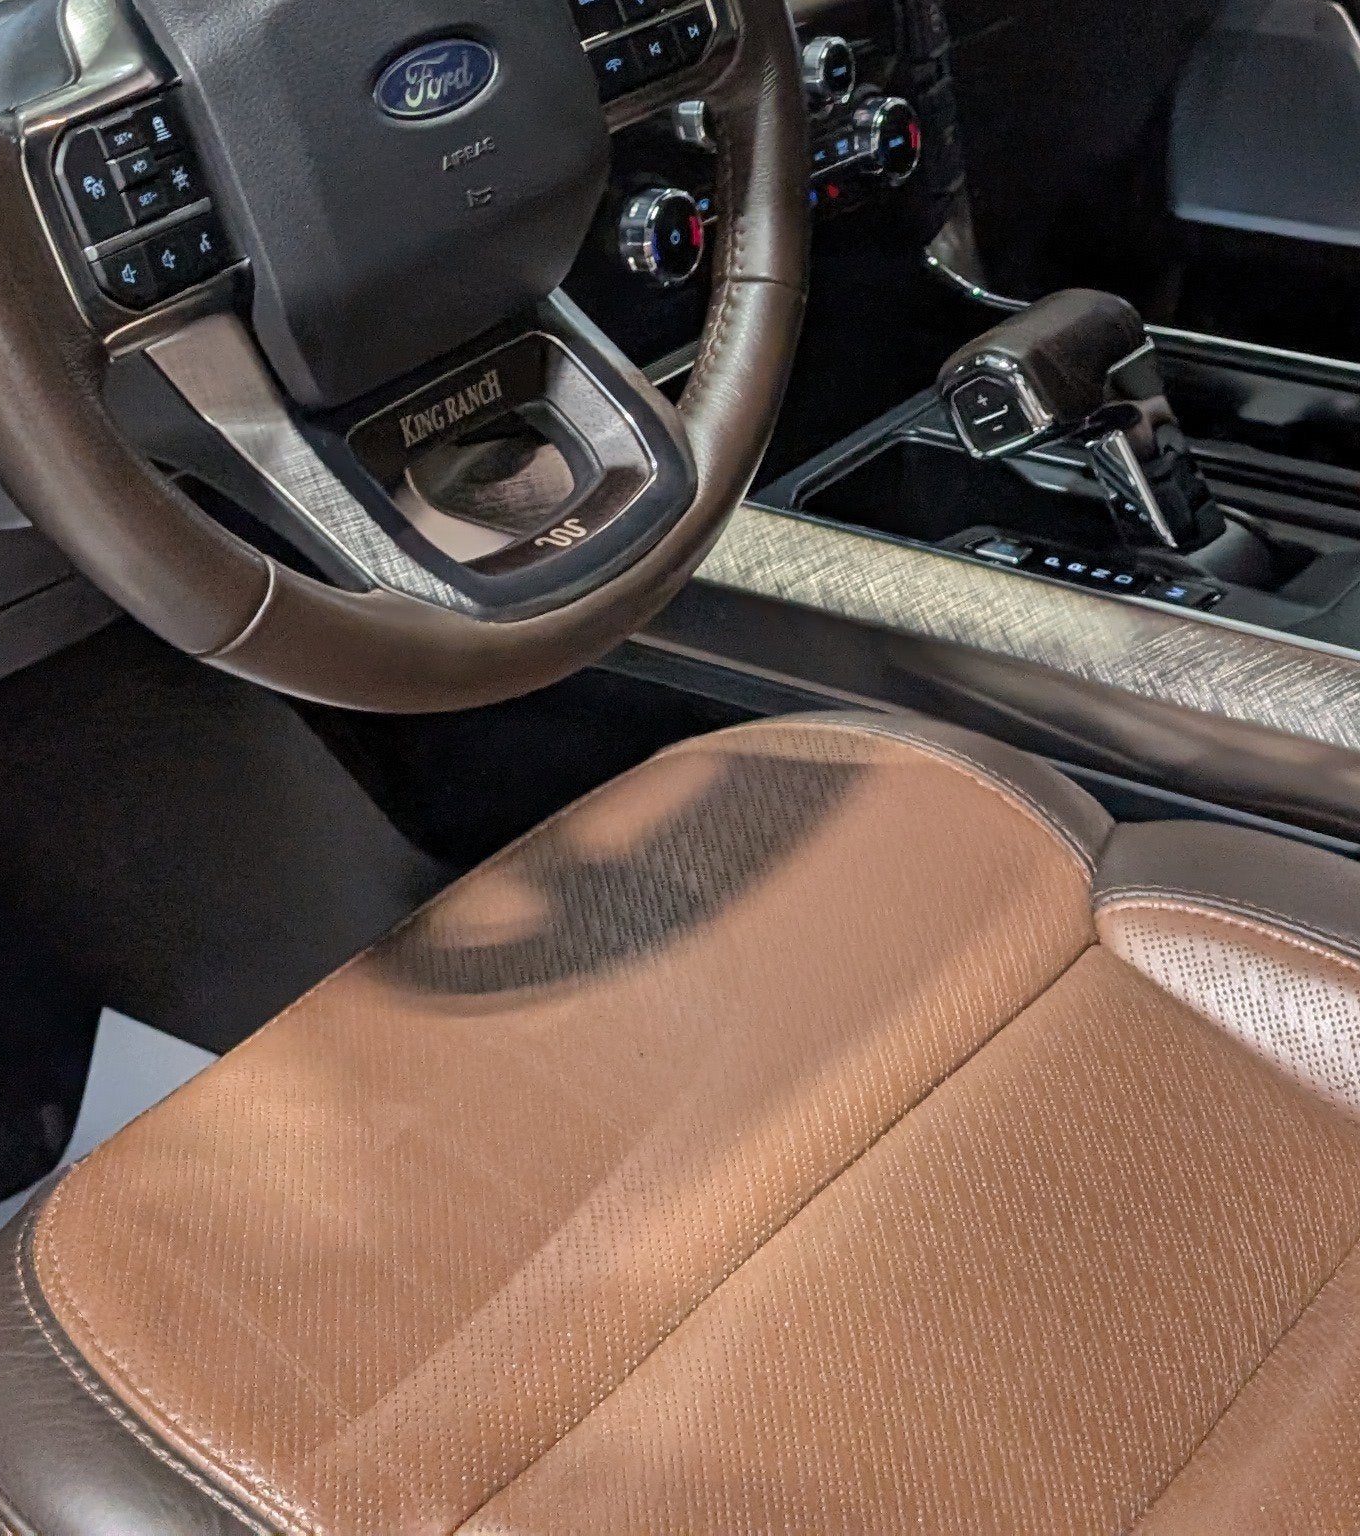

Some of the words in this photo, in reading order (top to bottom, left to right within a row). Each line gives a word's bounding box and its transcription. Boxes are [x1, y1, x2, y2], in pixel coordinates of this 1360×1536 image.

[404, 51, 474, 108] Ford
[399, 404, 446, 449] KING
[444, 369, 503, 425] RANCH
